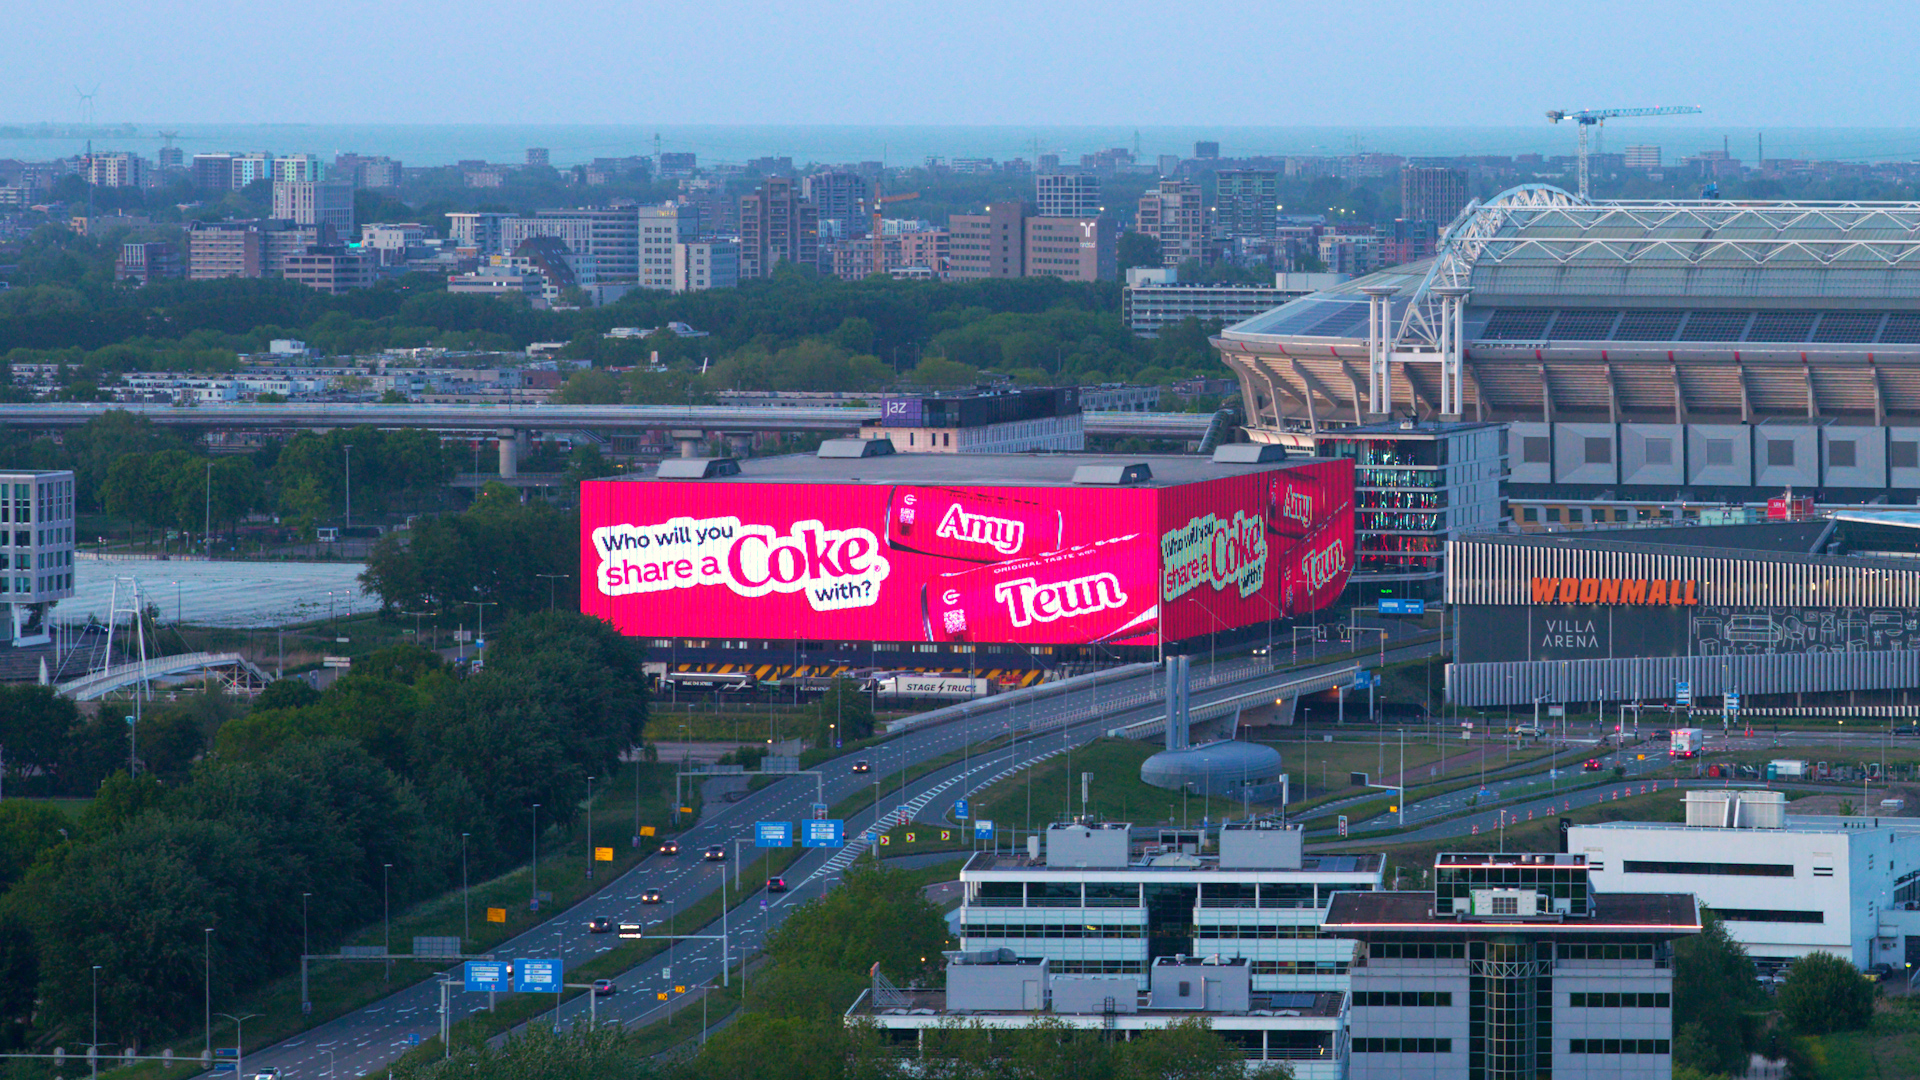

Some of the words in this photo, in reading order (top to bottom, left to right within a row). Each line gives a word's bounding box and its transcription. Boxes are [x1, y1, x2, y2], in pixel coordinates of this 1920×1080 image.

[1284, 484, 1312, 528] Amy
[602, 532, 650, 552] Who
[656, 526, 692, 546] will
[696, 525, 734, 544] you
[937, 503, 1024, 554] Amy
[1198, 522, 1214, 544] you
[606, 558, 693, 586] share
[701, 556, 721, 576] a
[994, 561, 1042, 574] ORIGINAL
[1044, 553, 1075, 563] TASTE
[1166, 558, 1199, 593] share
[1201, 554, 1209, 574] a
[1302, 539, 1345, 596] Teun
[815, 580, 872, 602] with?
[996, 572, 1128, 627] Teun
[1532, 577, 1698, 605] WOONMALL
[1546, 620, 1595, 633] VILLA
[1542, 634, 1599, 648] ARENA
